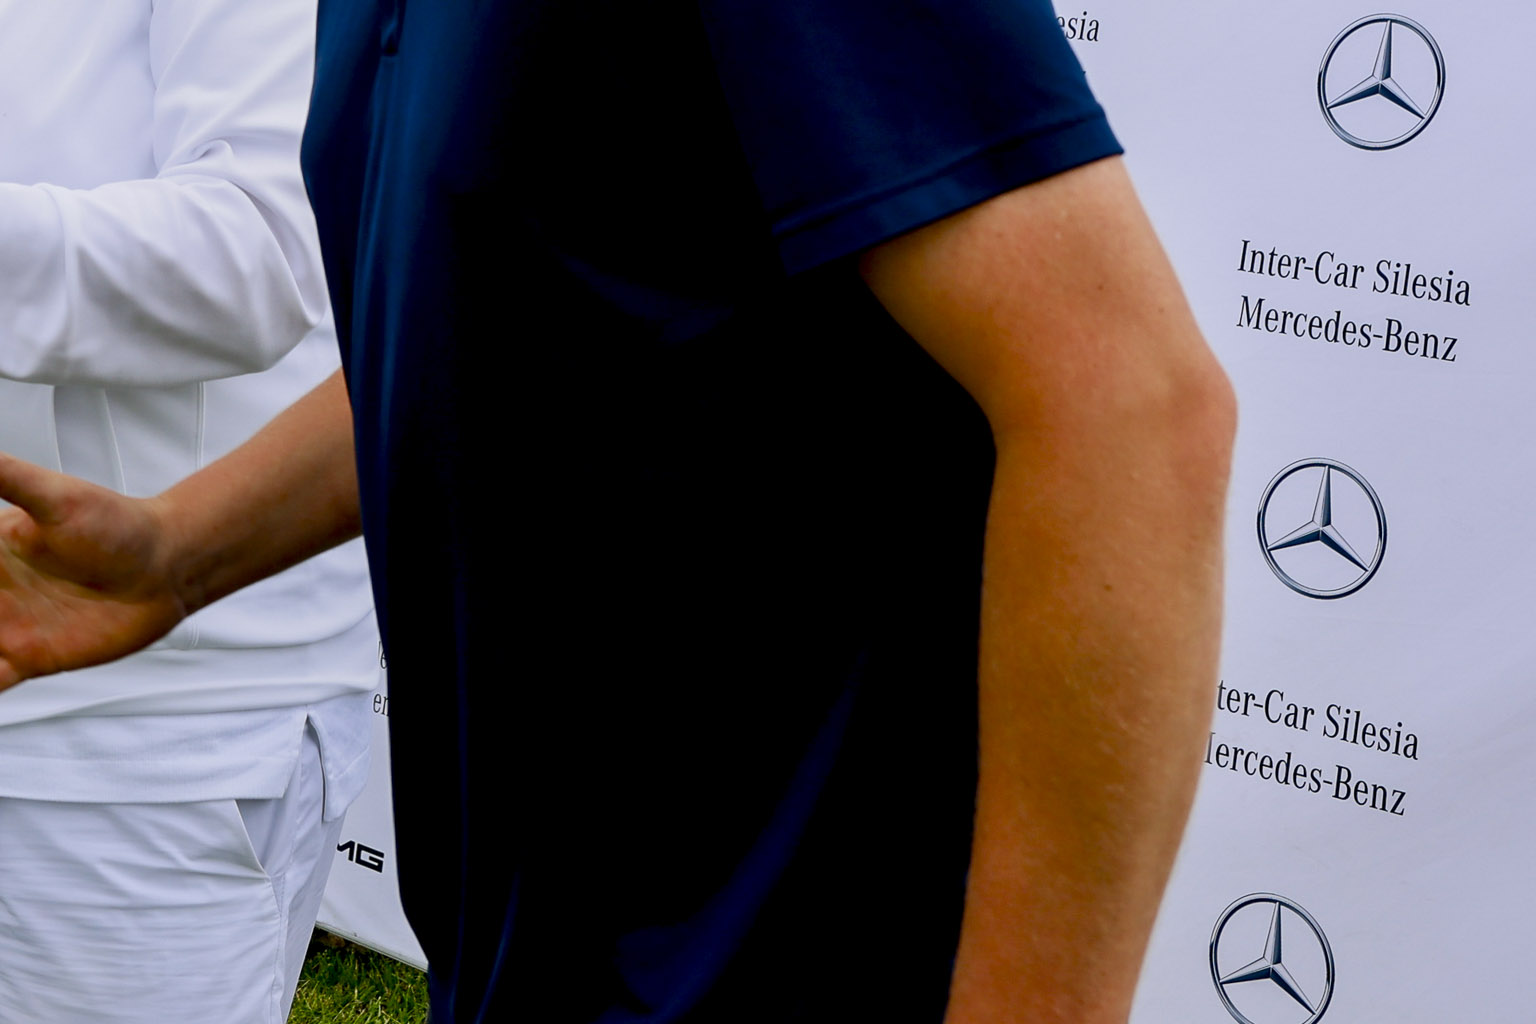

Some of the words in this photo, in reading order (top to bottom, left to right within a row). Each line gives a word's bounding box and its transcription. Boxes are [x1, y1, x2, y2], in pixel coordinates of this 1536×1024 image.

[1237, 240, 1364, 289] Inter-Car
[1372, 259, 1471, 307] Silesia
[1236, 295, 1459, 362] Mercedes-Benz
[1216, 680, 1315, 732] ter-Car
[1322, 704, 1419, 761] Silesia
